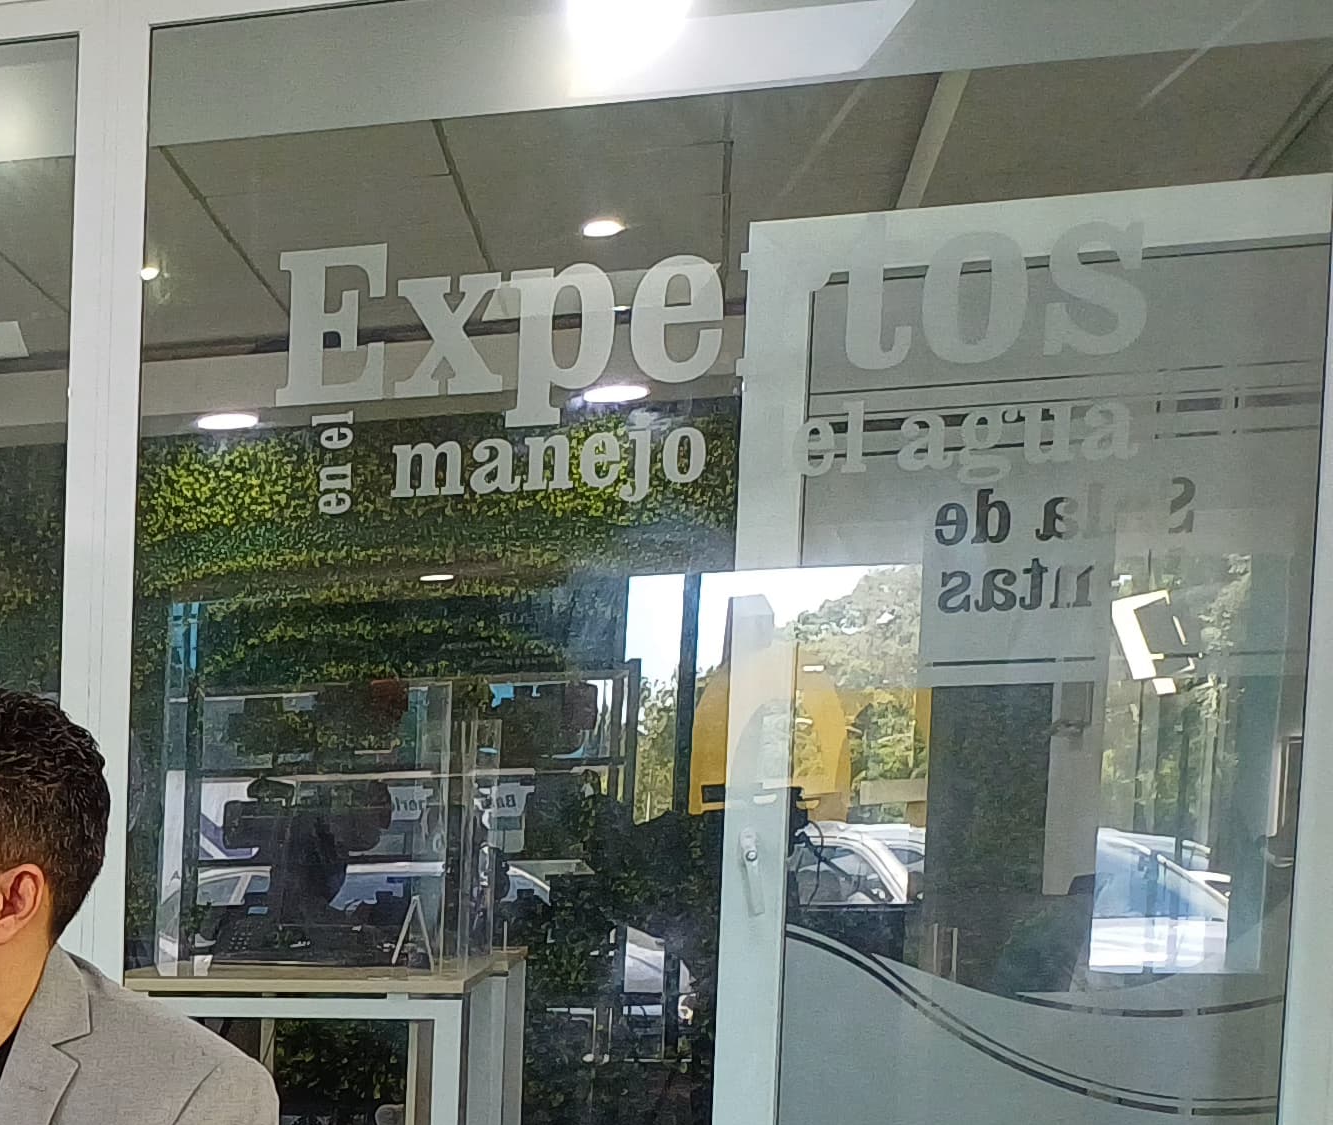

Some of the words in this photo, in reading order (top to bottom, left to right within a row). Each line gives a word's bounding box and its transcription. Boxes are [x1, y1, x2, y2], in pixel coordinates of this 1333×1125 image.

[311, 410, 355, 451] el
[390, 409, 707, 501] manejo
[792, 400, 867, 477] el
[898, 402, 1138, 484] agua
[317, 463, 352, 516] en
